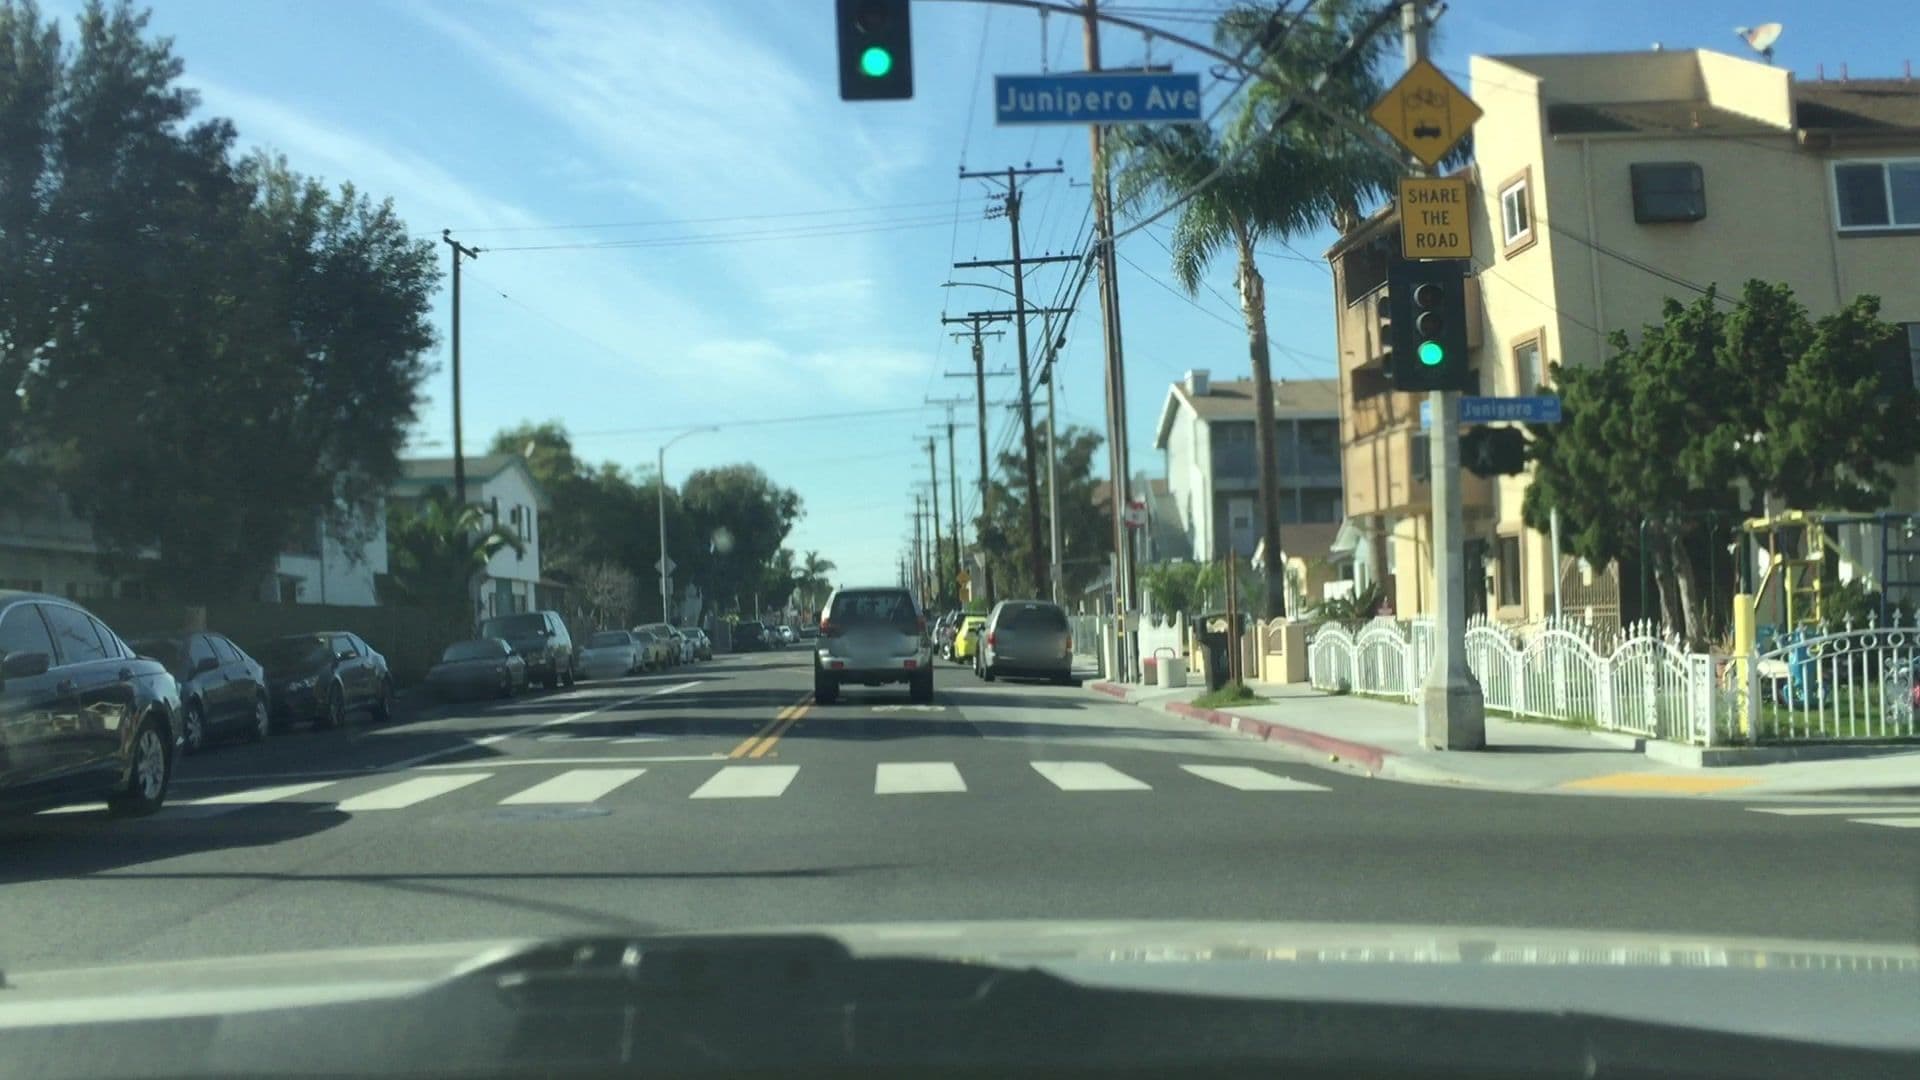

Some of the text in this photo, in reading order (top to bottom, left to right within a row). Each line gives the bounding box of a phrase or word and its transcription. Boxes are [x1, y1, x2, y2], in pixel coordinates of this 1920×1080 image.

[1001, 86, 1197, 116] Junipero Ave
[1408, 188, 1460, 204] SHARE
[1422, 210, 1449, 225] THE
[1416, 233, 1458, 248] ROAD
